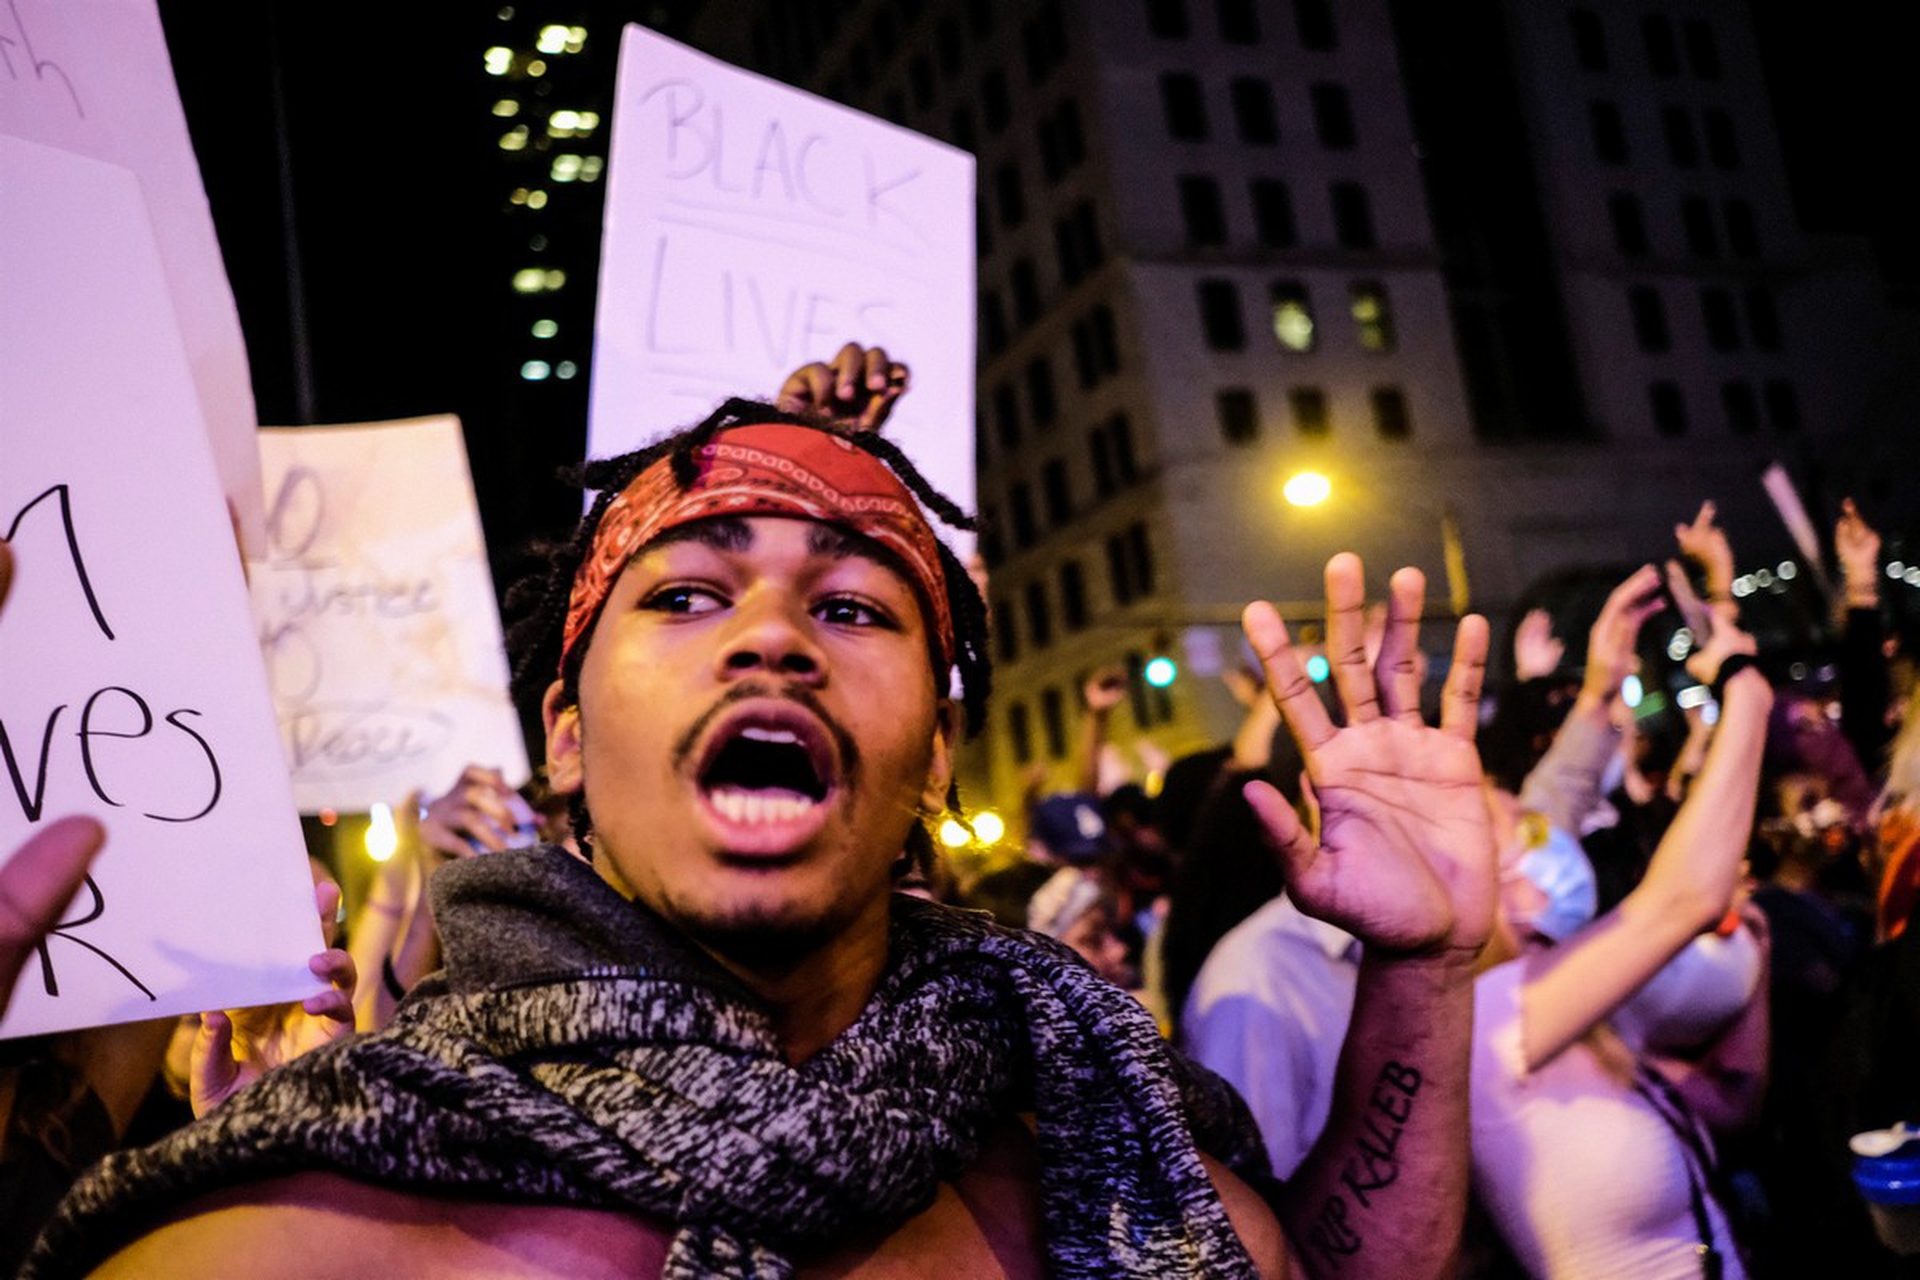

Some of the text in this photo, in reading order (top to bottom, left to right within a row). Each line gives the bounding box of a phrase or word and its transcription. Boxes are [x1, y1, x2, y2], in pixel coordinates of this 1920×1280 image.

[639, 80, 931, 243] BLACK
[645, 233, 898, 369] LIVES
[1309, 1060, 1422, 1270] RIP KALEB
